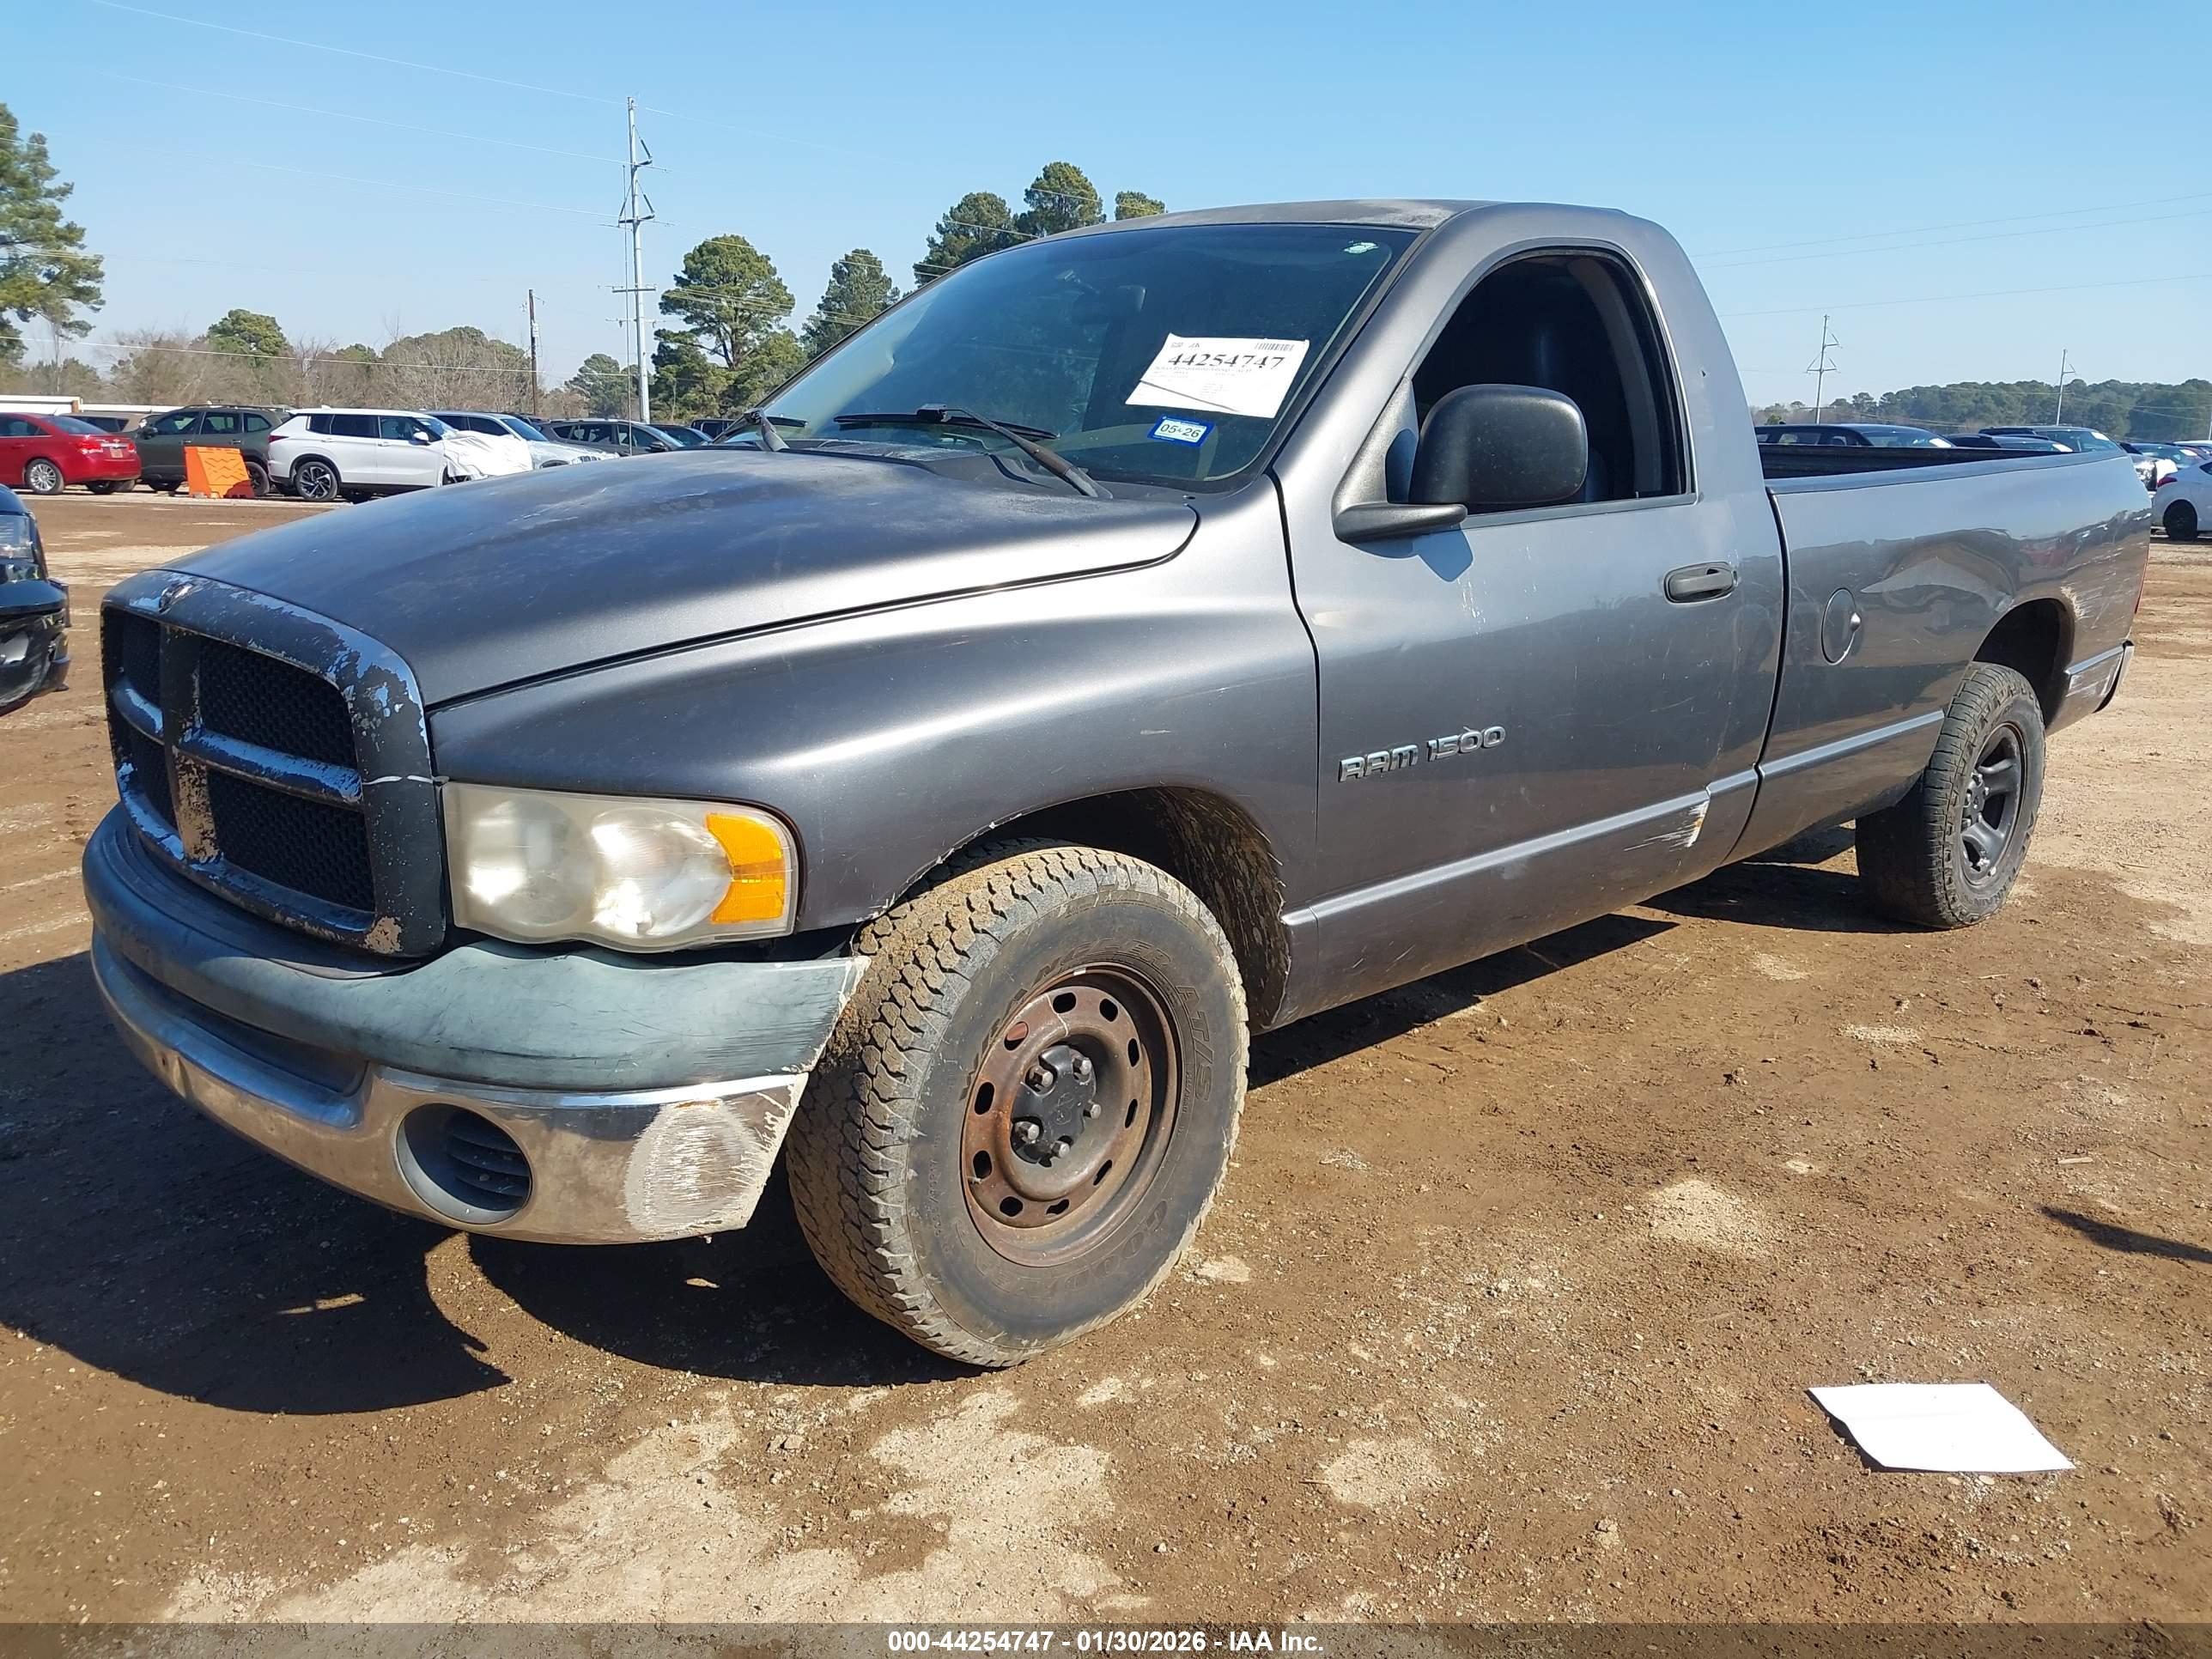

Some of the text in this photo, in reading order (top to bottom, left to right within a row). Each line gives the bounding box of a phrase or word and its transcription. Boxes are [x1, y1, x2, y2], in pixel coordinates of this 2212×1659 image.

[1168, 352, 1286, 370] 44254747
[1338, 726, 1506, 782] RAM 1500
